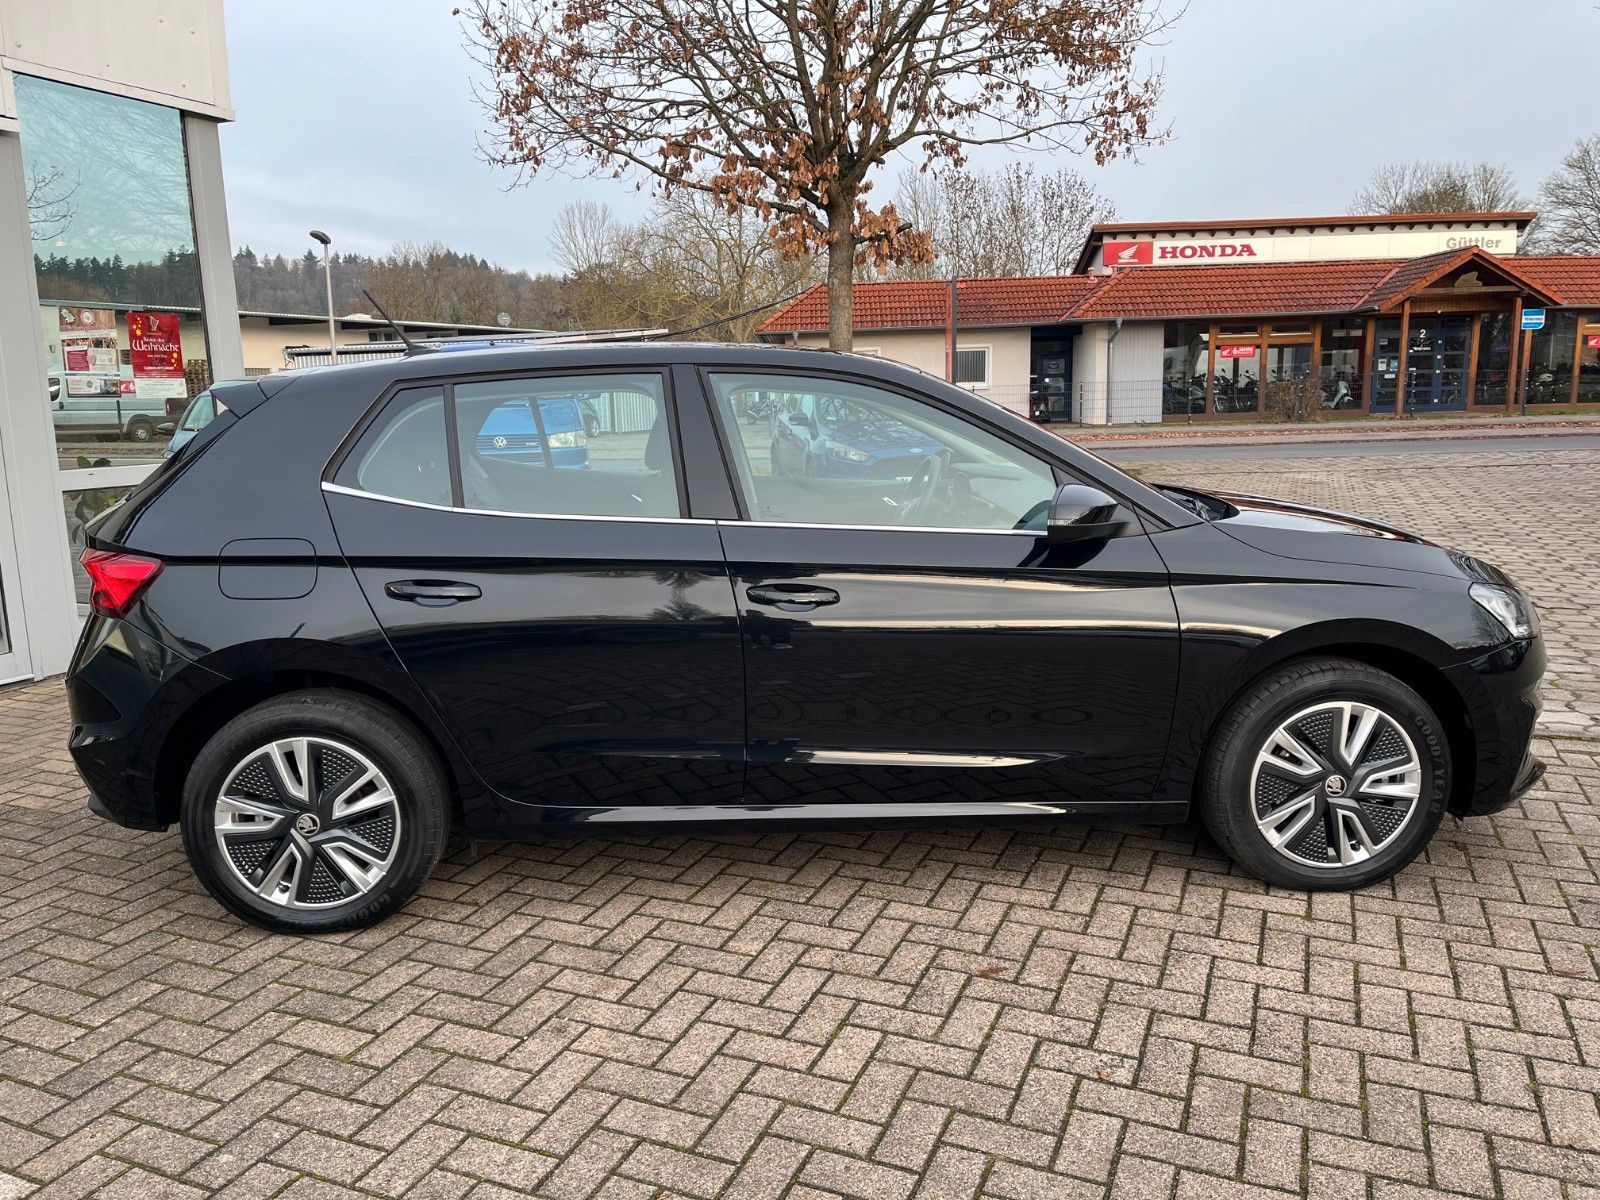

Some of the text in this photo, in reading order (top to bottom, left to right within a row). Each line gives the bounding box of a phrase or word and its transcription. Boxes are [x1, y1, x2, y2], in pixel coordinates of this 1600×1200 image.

[1446, 236, 1502, 249] Güttler
[1159, 244, 1257, 259] HONDA
[1420, 329, 1426, 338] 2
[132, 339, 180, 352] Weihnacht
